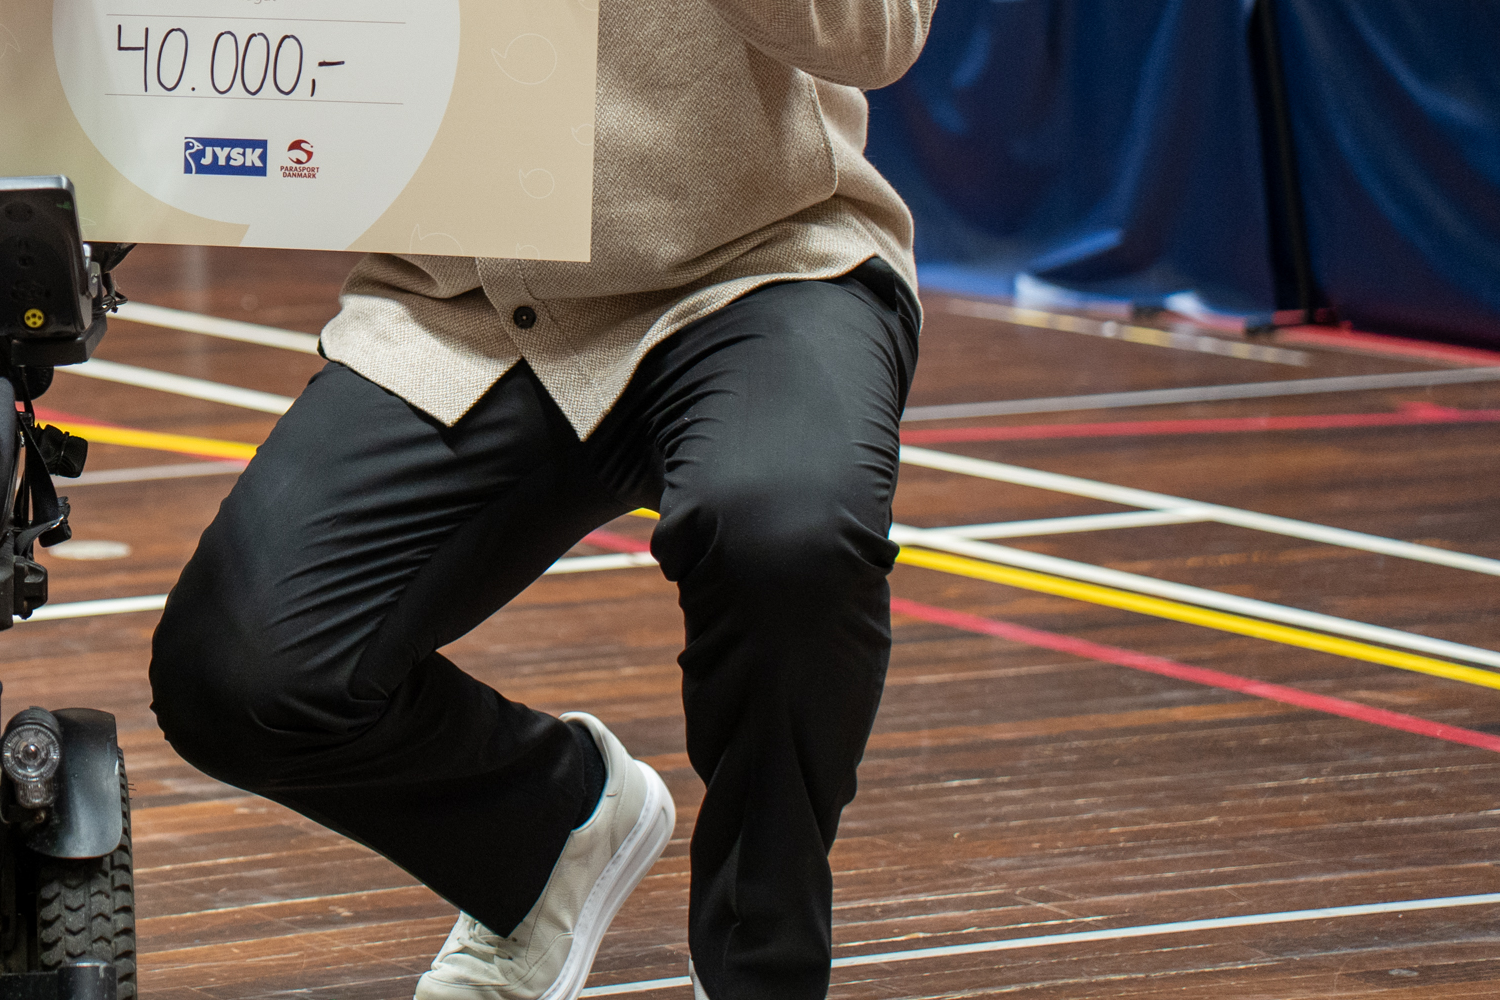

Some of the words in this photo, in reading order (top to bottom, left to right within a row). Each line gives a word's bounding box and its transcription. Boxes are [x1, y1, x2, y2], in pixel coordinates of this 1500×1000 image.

[116, 23, 346, 98] 40.000,-
[200, 146, 264, 167] JYSK
[280, 165, 320, 173] PARASPORT
[282, 171, 317, 179] DANMARK
